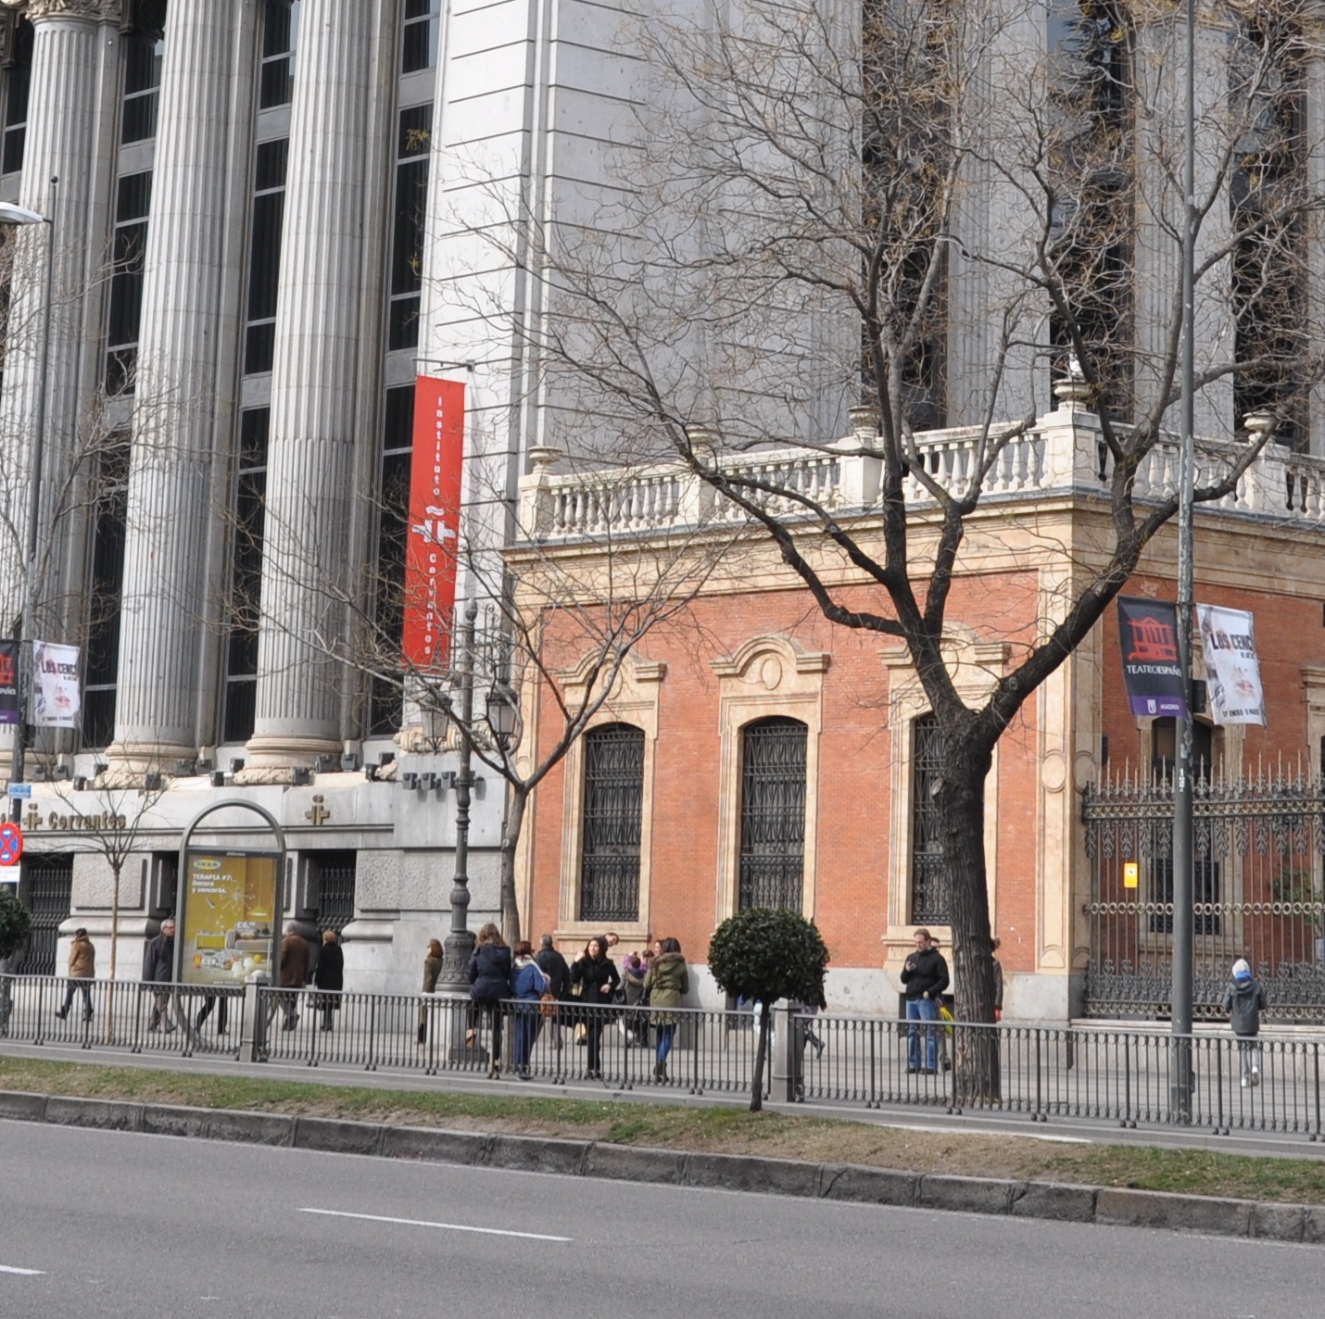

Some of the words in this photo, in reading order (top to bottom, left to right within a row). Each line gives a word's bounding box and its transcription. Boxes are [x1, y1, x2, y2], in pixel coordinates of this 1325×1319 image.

[433, 396, 443, 496] Instituto
[1210, 633, 1230, 649] LOS
[1231, 634, 1253, 650] CENC
[1127, 664, 1181, 676] TEATROESPAÑO
[48, 811, 127, 830] Cervantes
[192, 873, 220, 881] TERAPIA
